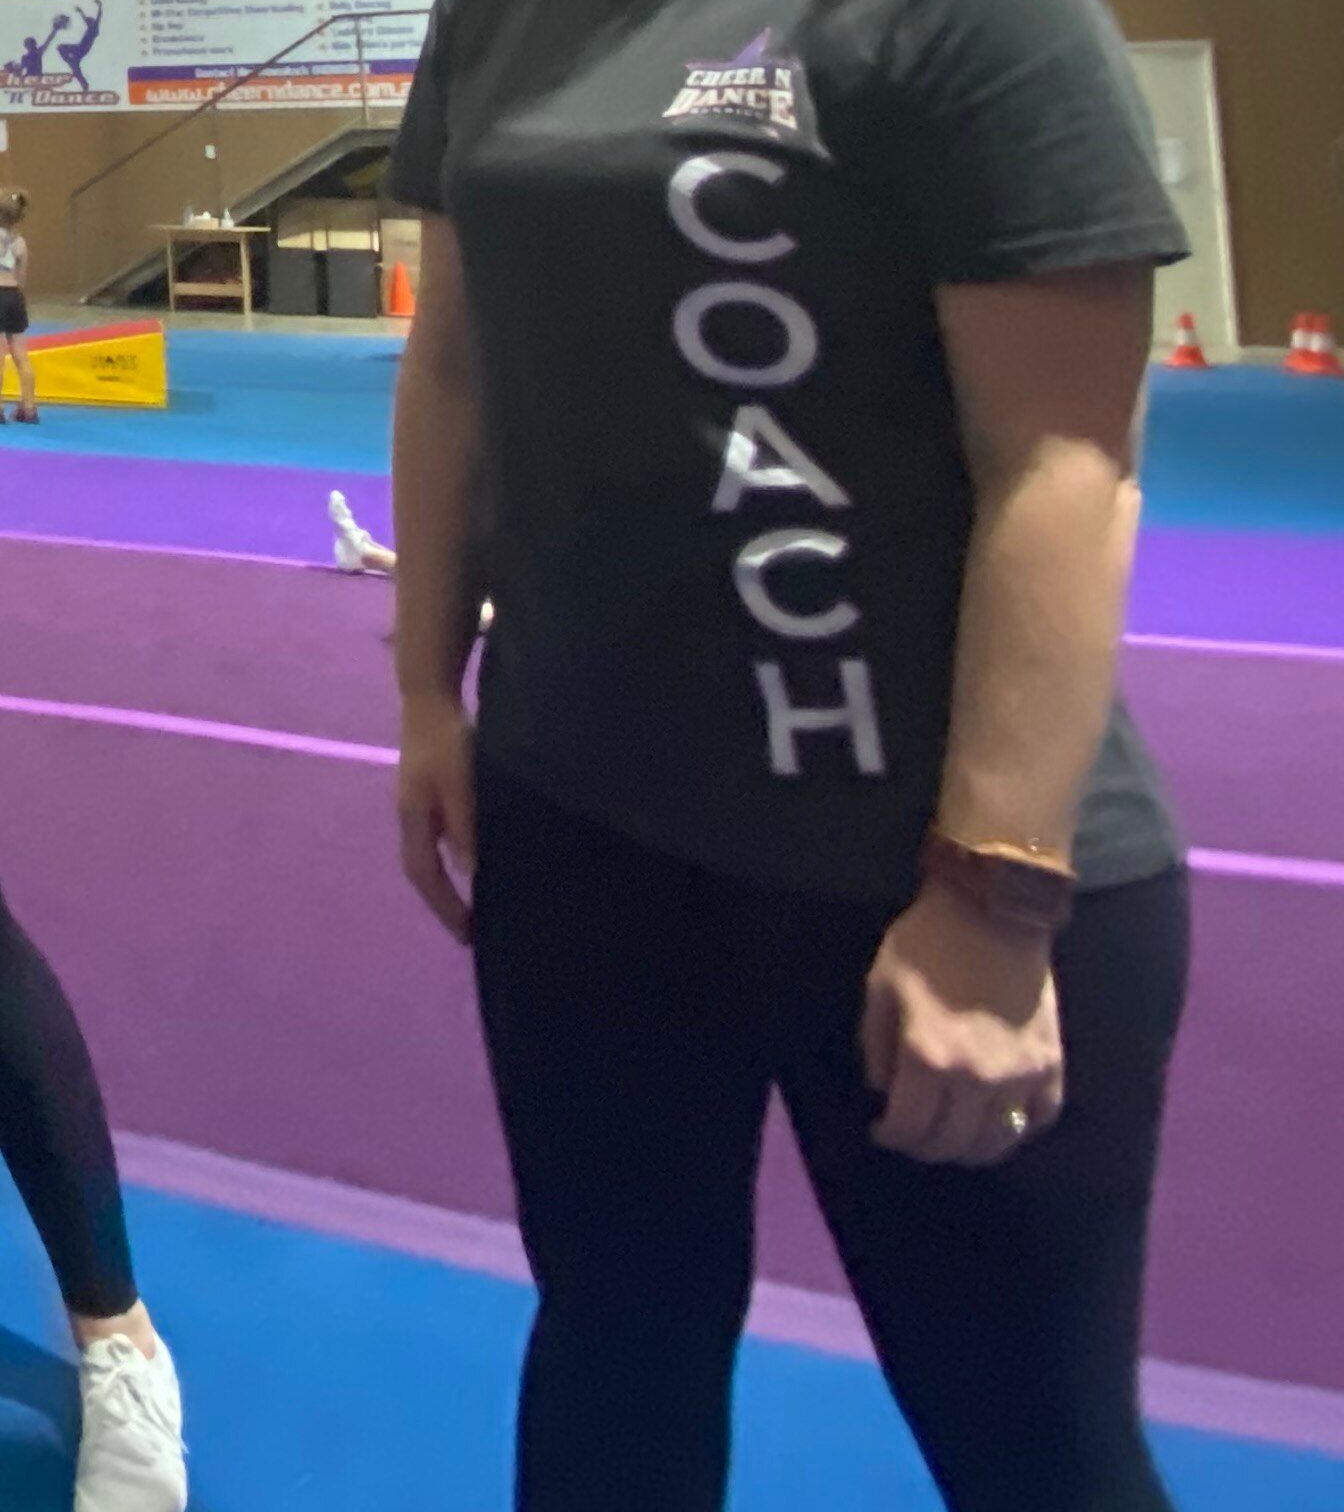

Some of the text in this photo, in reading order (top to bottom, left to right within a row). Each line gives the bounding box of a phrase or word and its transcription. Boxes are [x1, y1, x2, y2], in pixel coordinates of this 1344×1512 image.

[685, 67, 792, 90] CHEER N
[34, 90, 115, 105] Dance
[662, 87, 799, 131] DANCE
[666, 150, 886, 777] COACH
